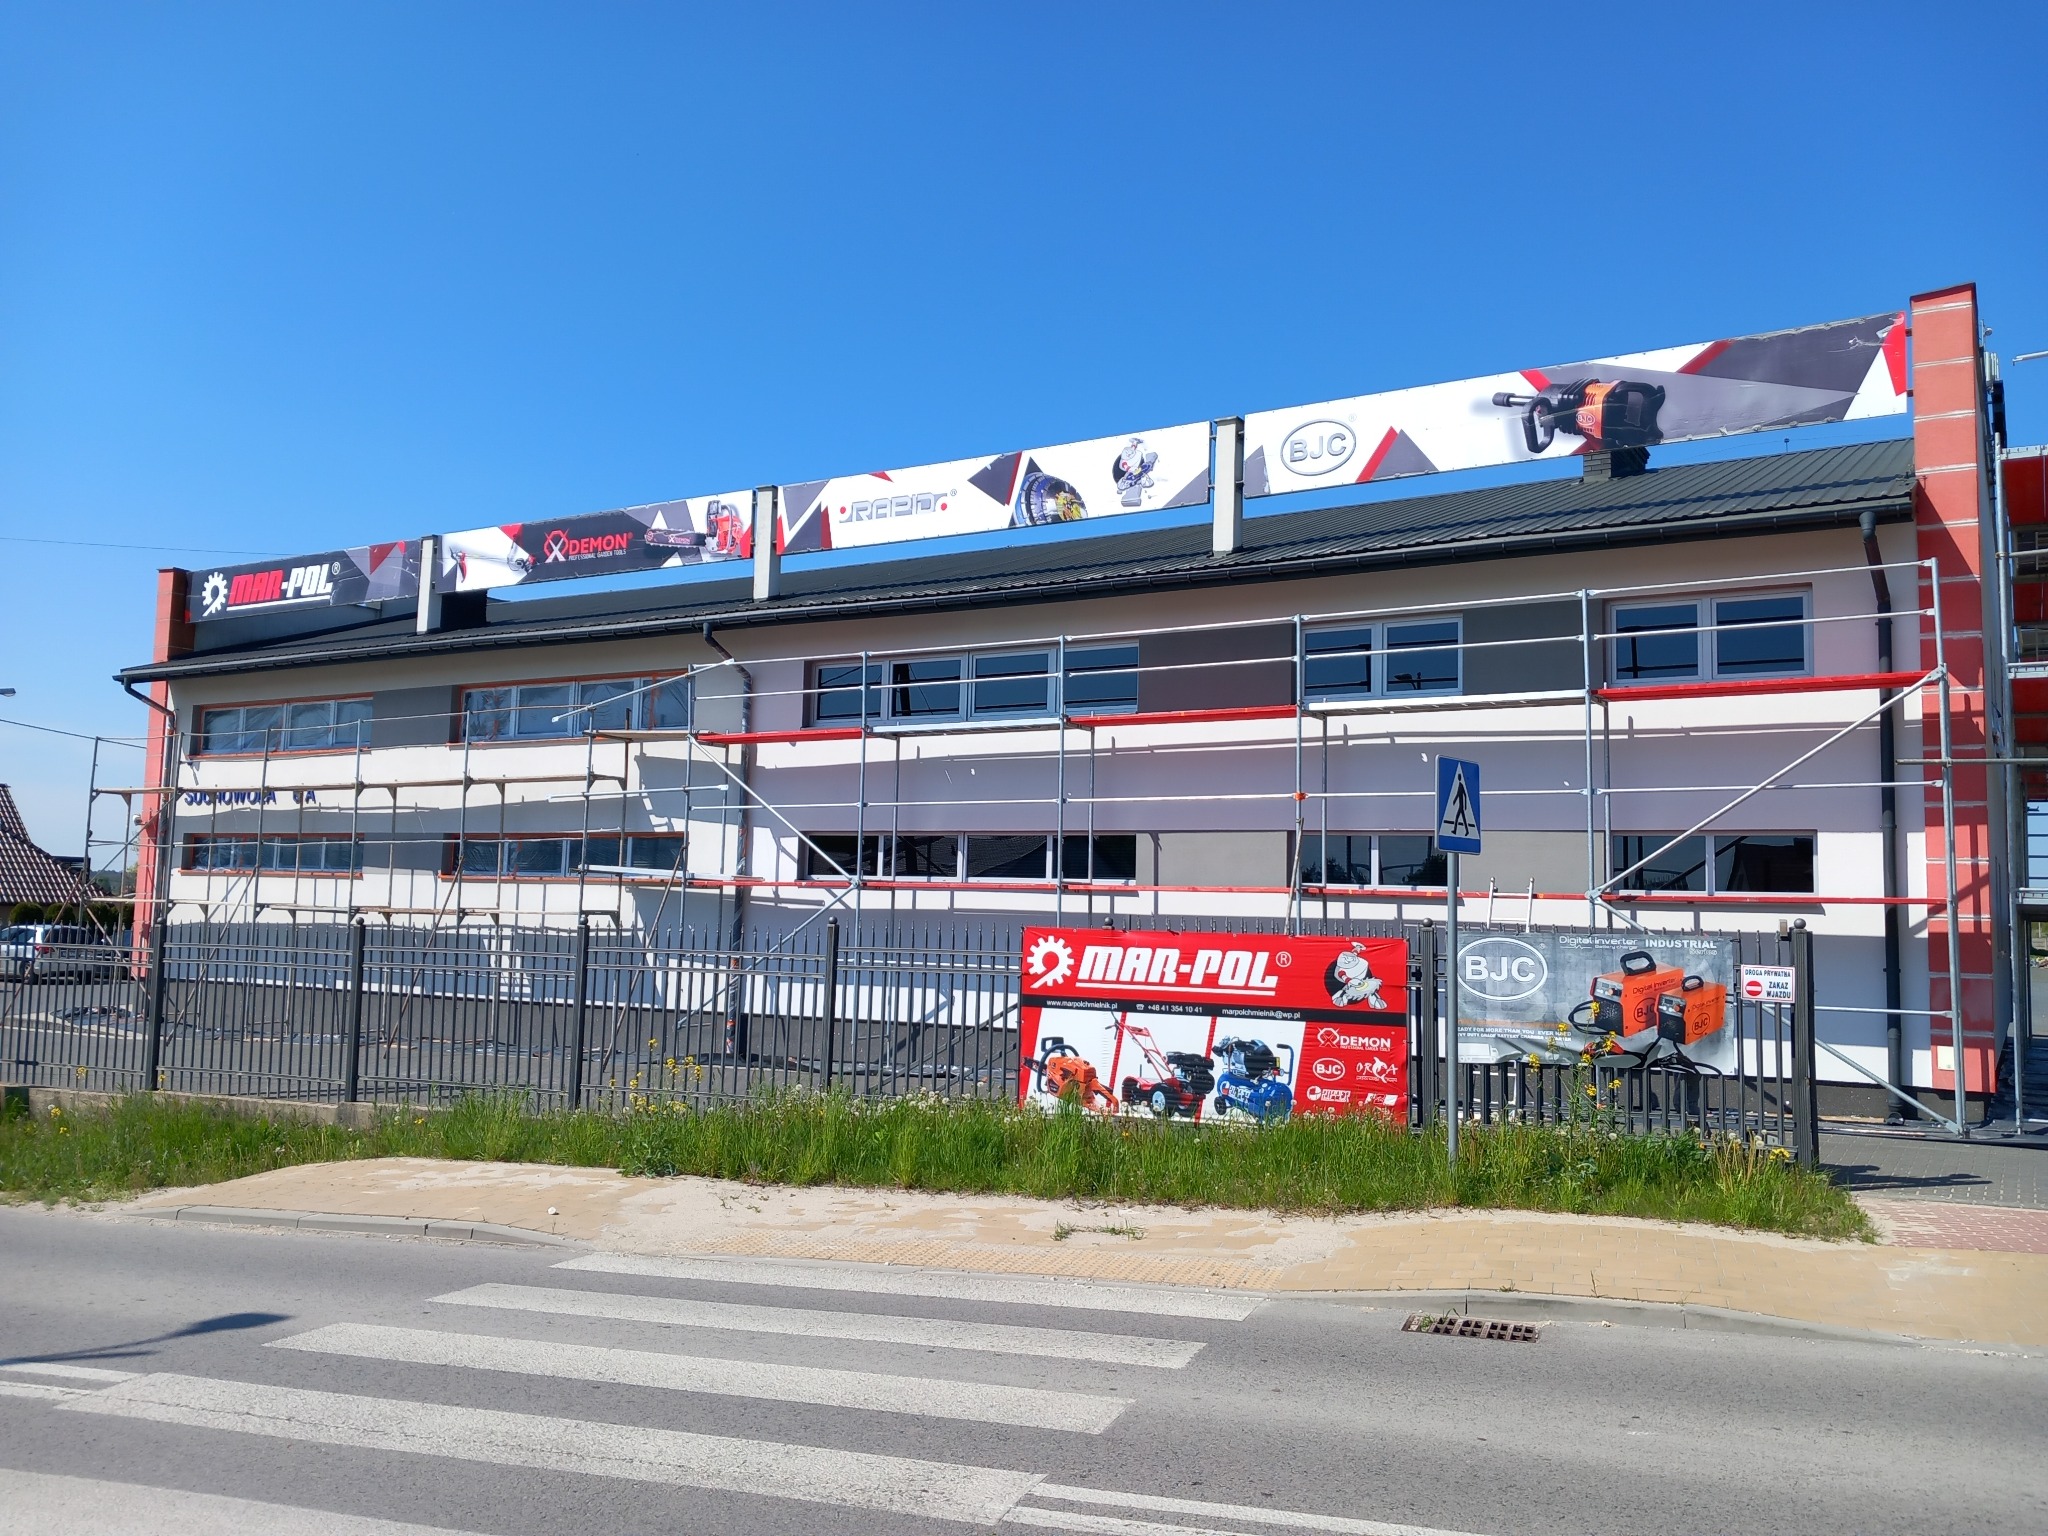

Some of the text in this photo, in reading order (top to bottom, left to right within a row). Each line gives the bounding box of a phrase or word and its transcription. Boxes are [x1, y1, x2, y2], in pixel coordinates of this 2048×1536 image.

[1289, 432, 1347, 463] BJC
[847, 491, 940, 523] RAPID
[568, 532, 628, 555] DEMON
[597, 550, 613, 558] GARDEN
[613, 548, 627, 556] TOOLS
[227, 563, 334, 606] MAR-POL
[1558, 935, 1593, 947] Digital
[1645, 938, 1717, 949] INDUSTRIAL
[1076, 945, 1279, 989] MAR-POL
[1465, 955, 1536, 982] BJC
[1745, 968, 1791, 978] DROGA PRYWATNA
[1768, 981, 1789, 990] ZAKAZ
[1766, 990, 1791, 999] WJAZDU
[1046, 1000, 1118, 1010] www.marpolchmielnik.pl
[1148, 1004, 1159, 1012] +48
[1161, 1004, 1169, 1012] 41
[1170, 1005, 1183, 1013] 354
[1185, 1005, 1193, 1013] 10
[1221, 1008, 1301, 1019] marpolchmielnik@wp.pl
[1694, 1017, 1709, 1031] BJC
[1340, 1035, 1391, 1048] DEMON
[1316, 1063, 1342, 1075] BJC
